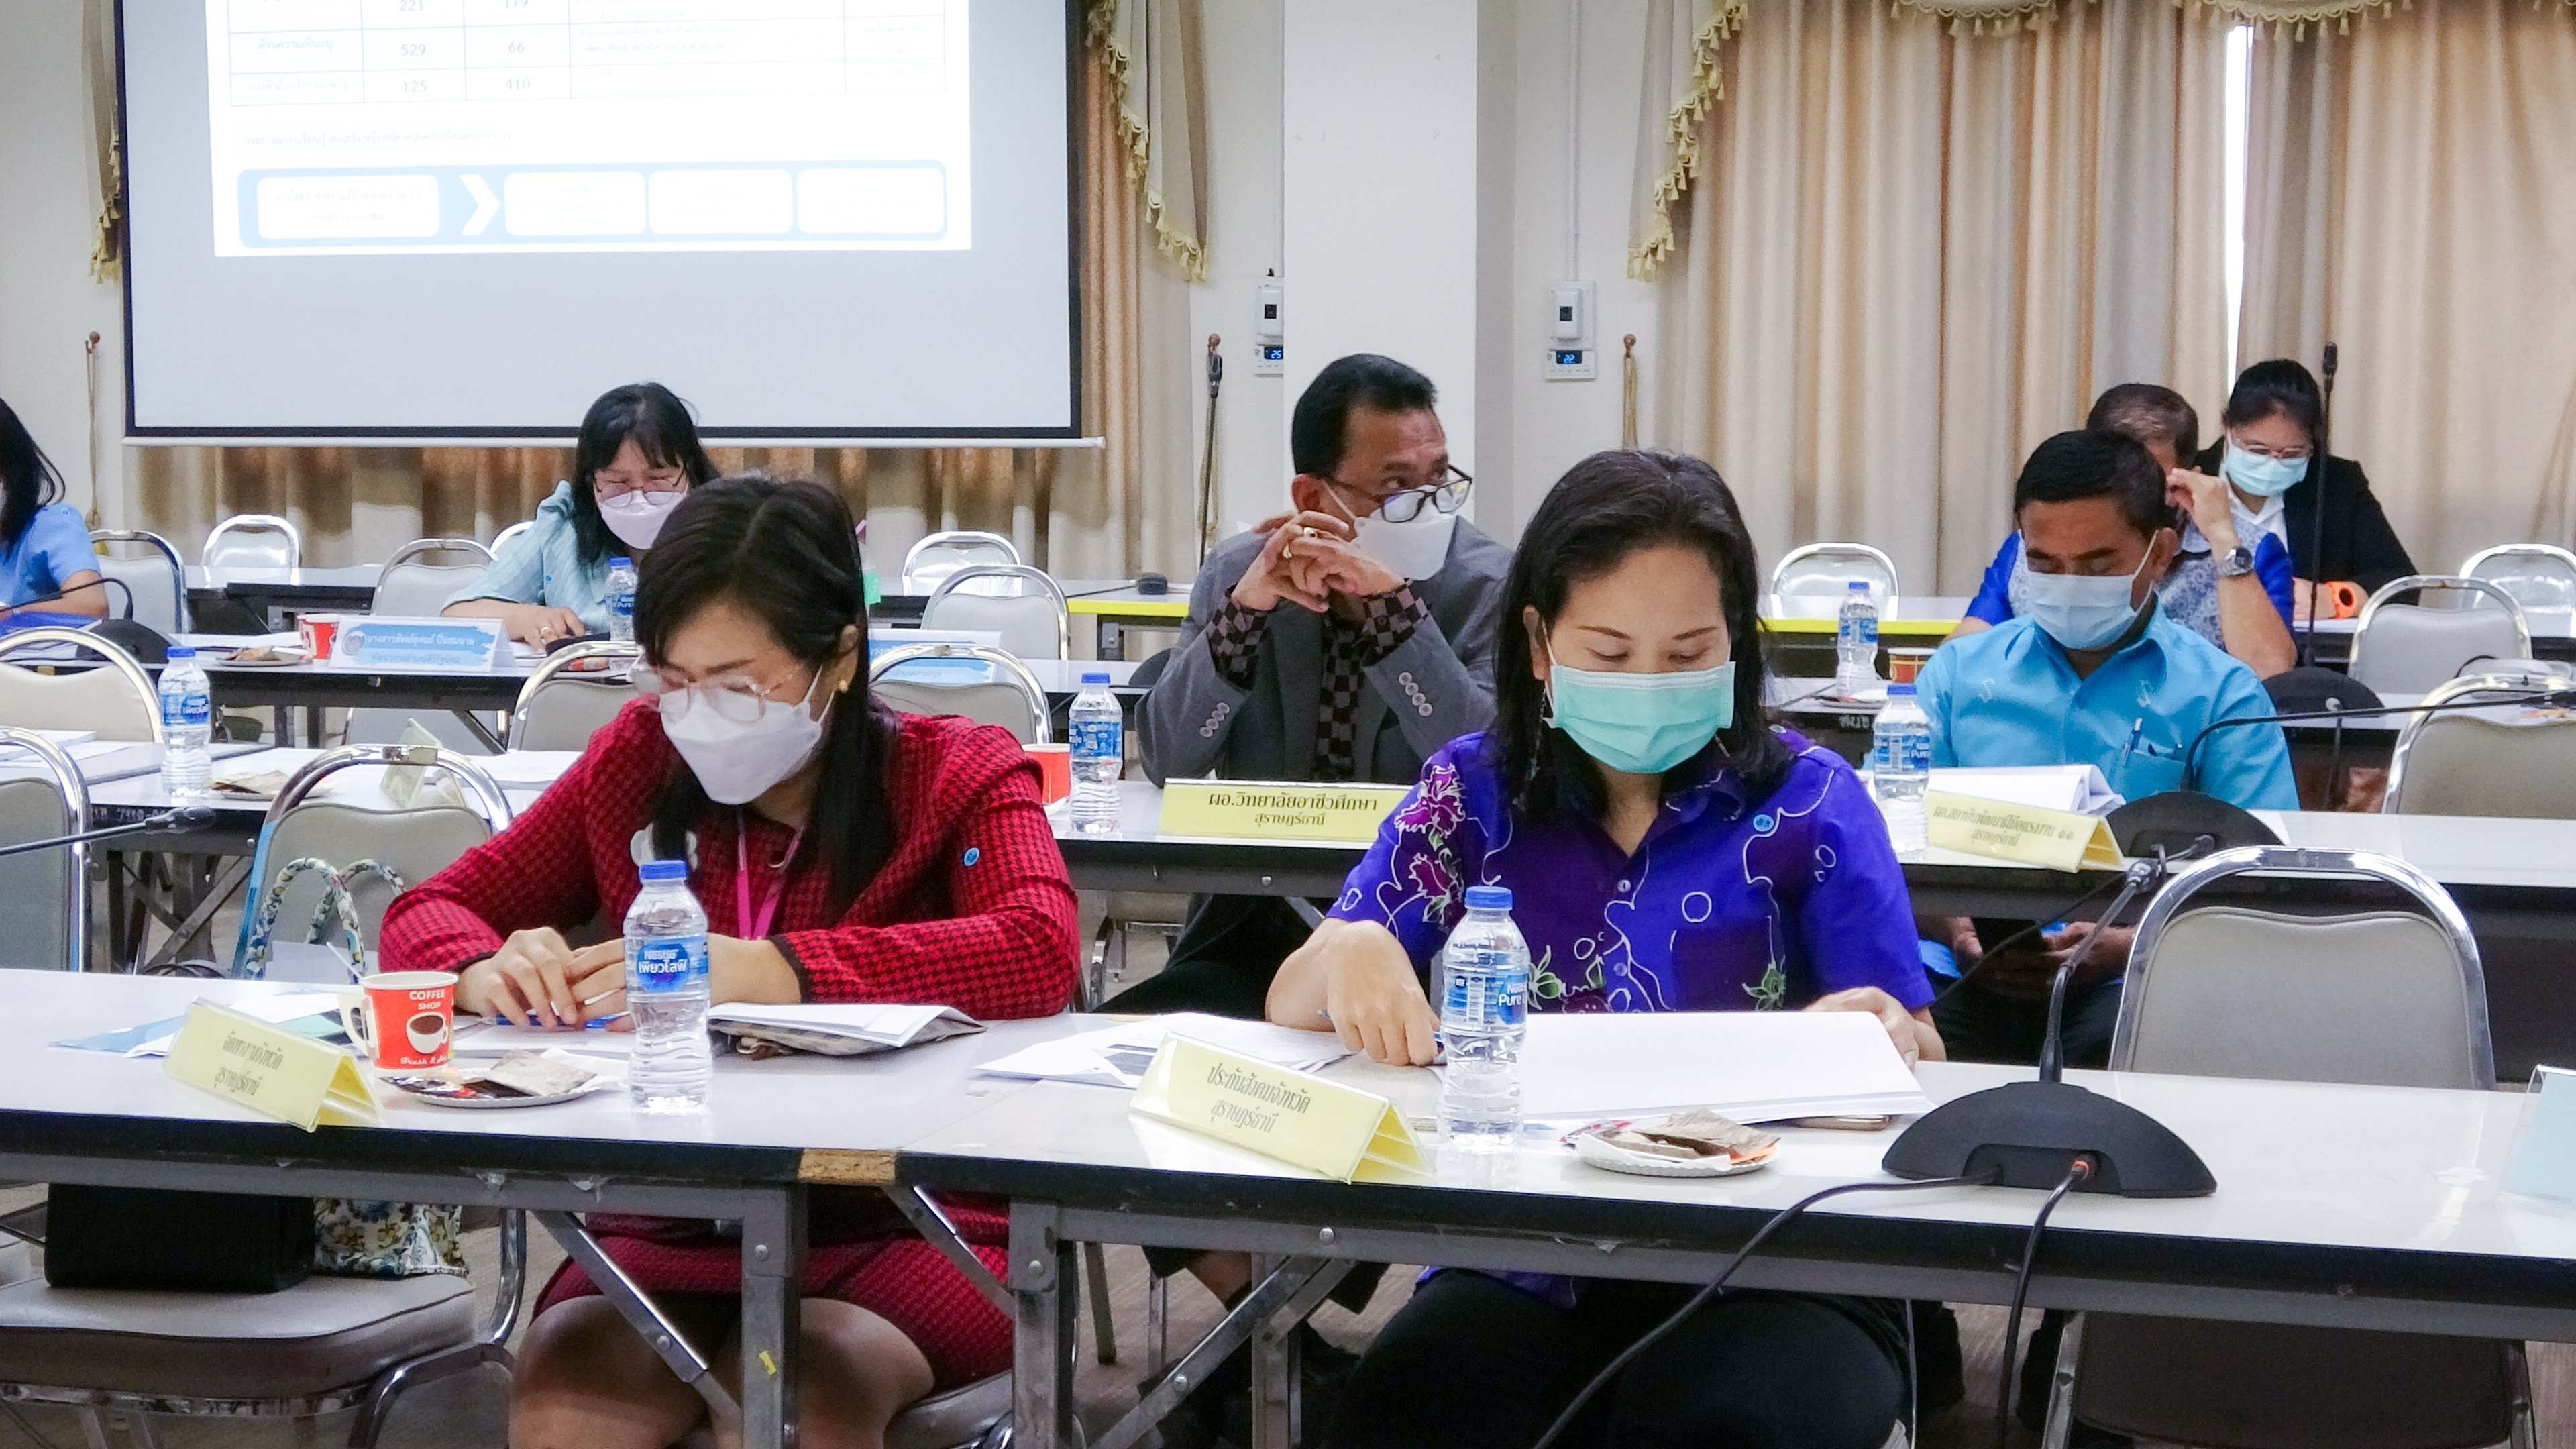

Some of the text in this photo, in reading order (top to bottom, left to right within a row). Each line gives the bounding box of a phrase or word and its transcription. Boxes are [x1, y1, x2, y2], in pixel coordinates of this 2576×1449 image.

[399, 0, 424, 11] 221
[258, 36, 333, 52] ด้านความเป็นอยู่
[400, 43, 426, 56] 529
[508, 41, 525, 54] 66
[403, 80, 427, 93] 125
[504, 78, 530, 91] 410
[1271, 350, 1282, 360] 25
[1208, 791, 1378, 812] ผอ.วิทยาลัยอาชีวศึกษา
[1254, 812, 1326, 827] สุราษฎร์ธานี
[409, 989, 446, 1000] COFFEE
[1498, 994, 1522, 1006] Pure
[417, 1001, 441, 1010] SHOP
[1207, 1062, 1311, 1114] ประกันสังคมจังหวัด
[1210, 1099, 1279, 1134] สุราษฎร์ธานี
